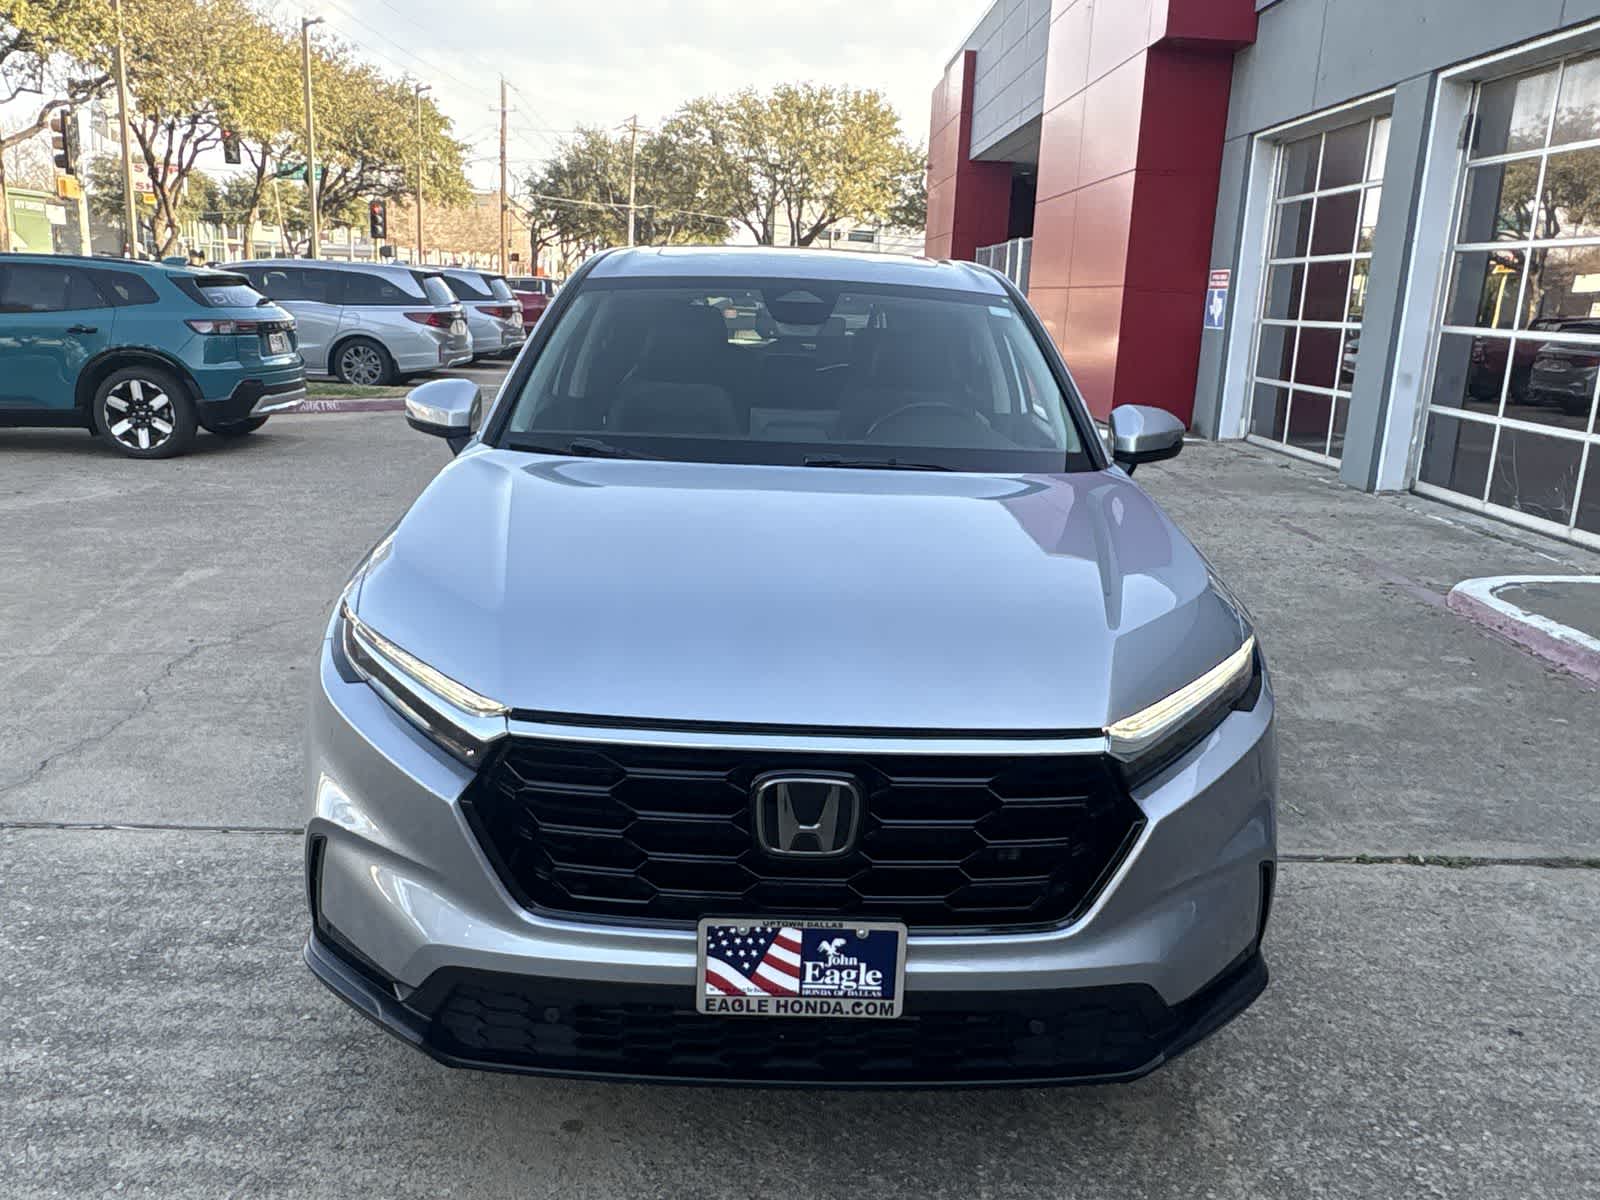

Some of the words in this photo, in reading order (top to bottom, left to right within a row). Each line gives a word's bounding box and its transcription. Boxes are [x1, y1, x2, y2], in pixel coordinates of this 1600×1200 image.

[762, 920, 803, 928] UPTOWN
[807, 921, 844, 929] DALLAS
[824, 953, 858, 968] John
[803, 961, 883, 991] Eagle
[847, 989, 882, 997] DALLAS
[704, 998, 769, 1014] EAGLE
[775, 999, 895, 1017] HONDA.COM
